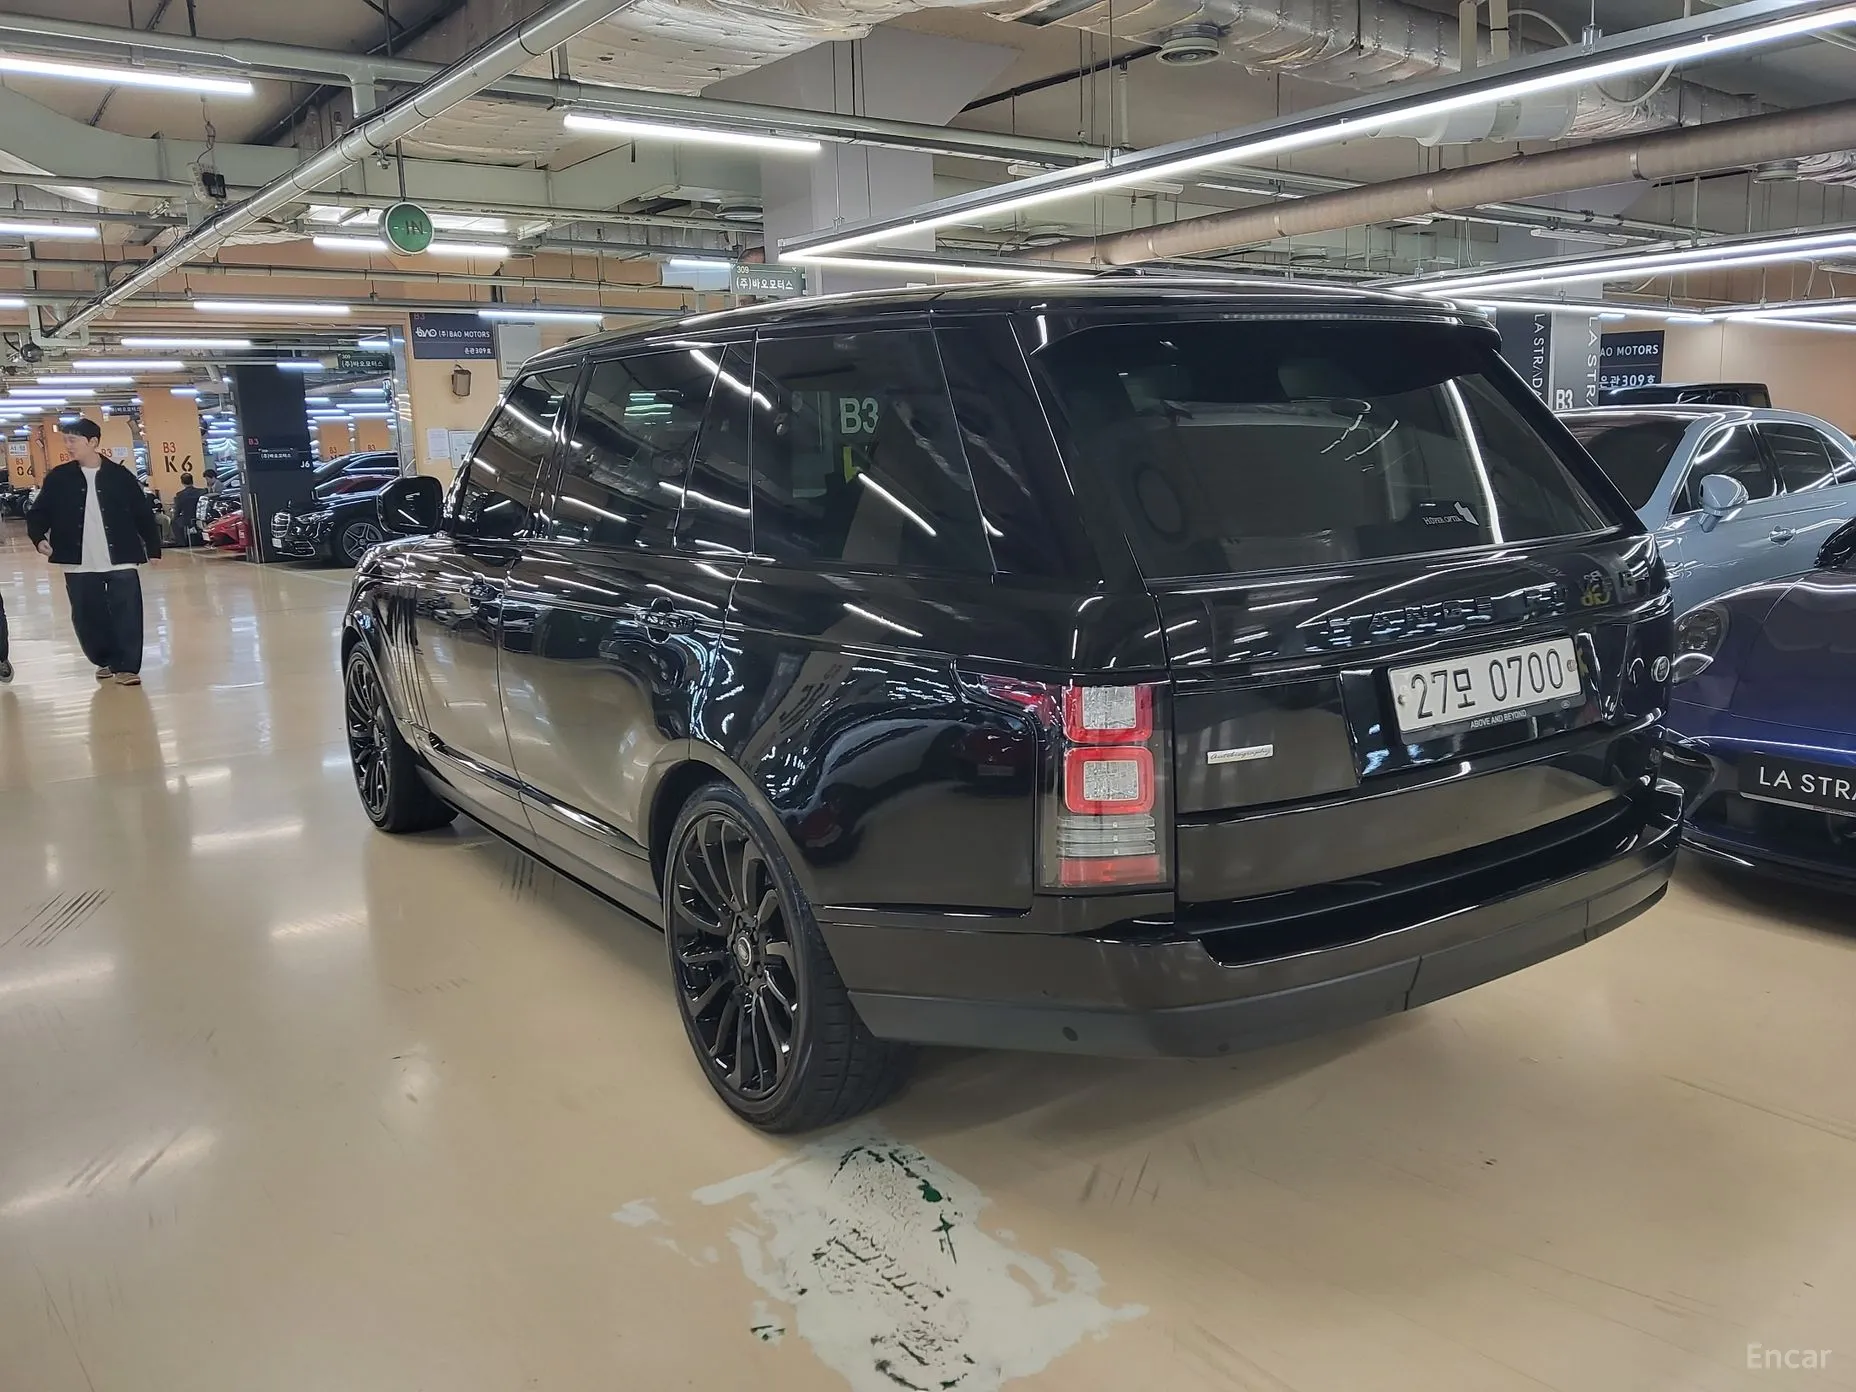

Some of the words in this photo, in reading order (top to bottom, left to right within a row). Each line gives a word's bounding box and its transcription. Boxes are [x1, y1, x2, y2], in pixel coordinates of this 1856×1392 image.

[736, 265, 750, 274] 309
[736, 276, 794, 291] (주)바오모터스
[1588, 316, 1598, 347] LA
[1616, 344, 1659, 356] MOTORS
[1556, 389, 1573, 410] B3
[840, 397, 879, 434] B3
[163, 441, 176, 453] B3
[300, 460, 310, 468] J6
[1410, 668, 1475, 719] 27모
[1488, 648, 1564, 701] 0700
[1470, 717, 1491, 728] ABOVE
[1490, 714, 1503, 724] AND
[1504, 709, 1527, 721] BEYOND
[1759, 766, 1793, 790] LA
